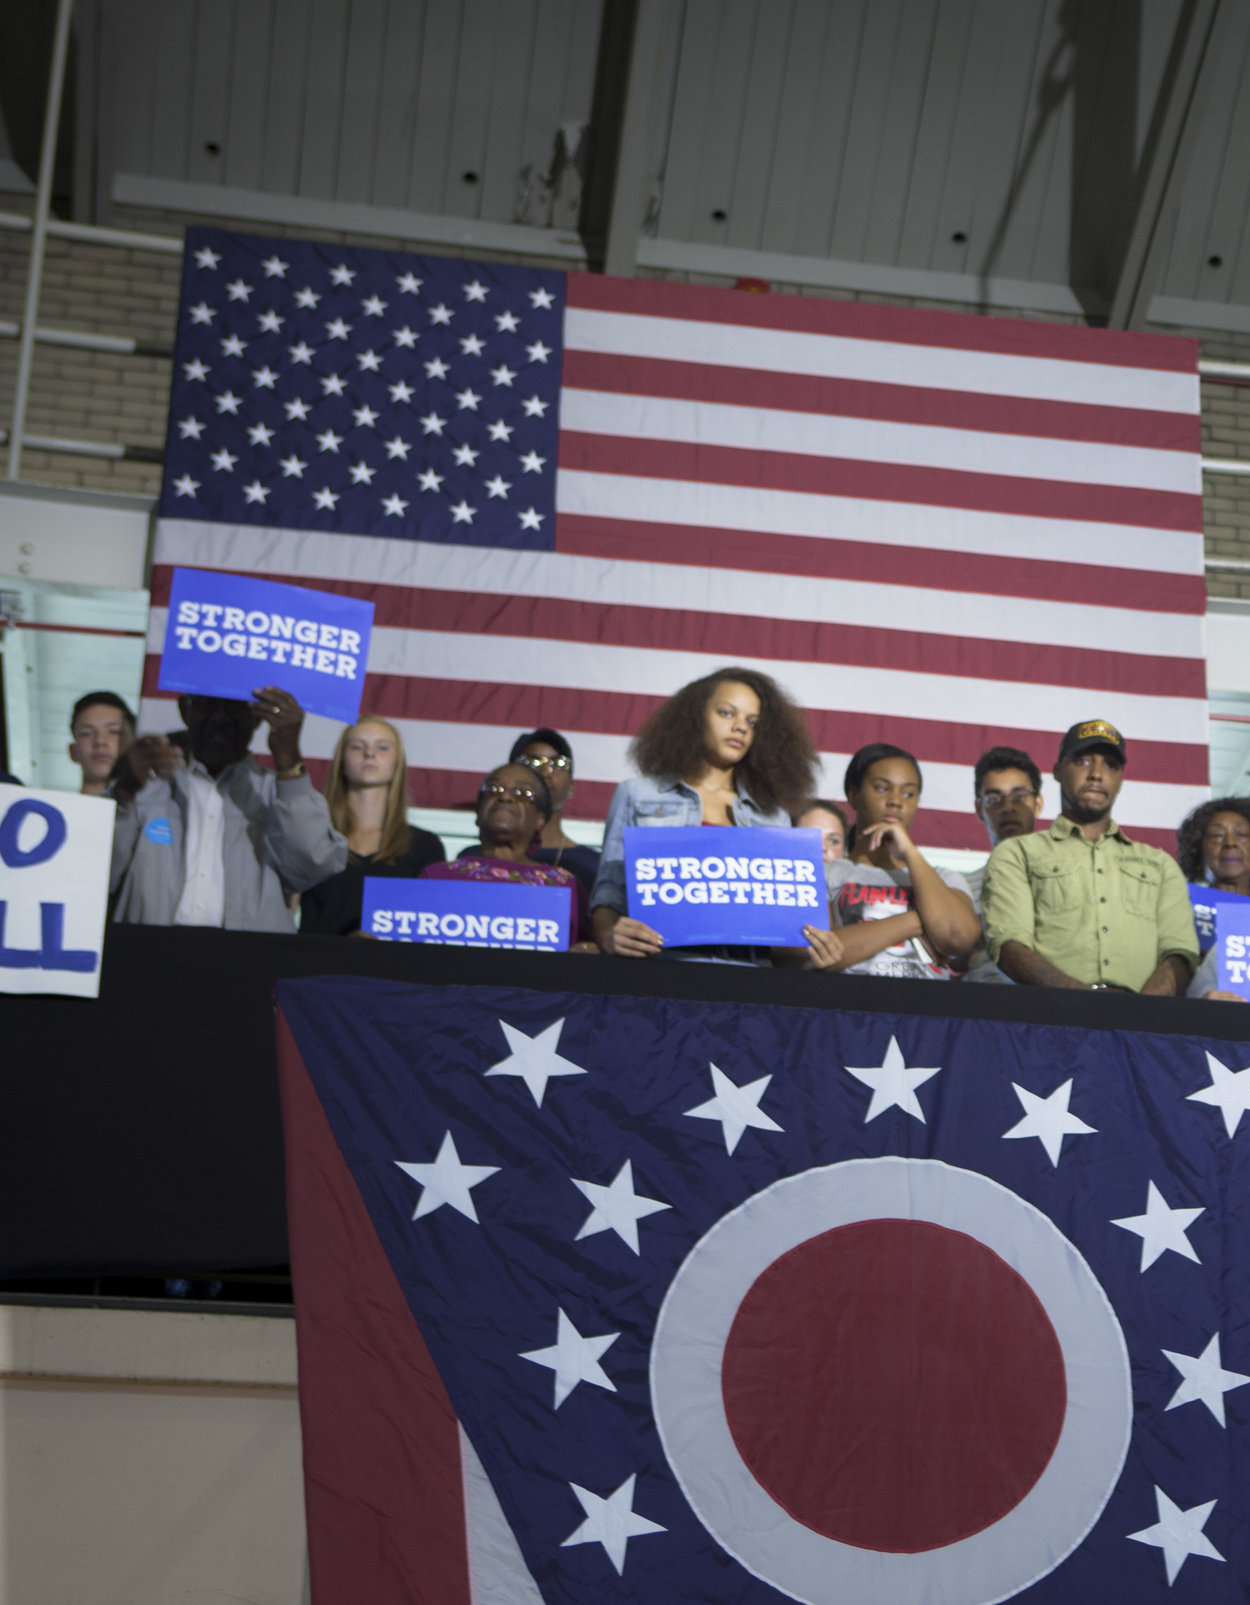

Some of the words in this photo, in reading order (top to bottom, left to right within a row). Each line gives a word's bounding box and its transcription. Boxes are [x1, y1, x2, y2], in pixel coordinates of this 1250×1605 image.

[176, 600, 362, 655] STRONGER
[174, 626, 358, 680] TOGETHER
[635, 856, 817, 882] STRONGER
[636, 881, 819, 908] TOGETHER
[372, 910, 560, 944] STRONGER
